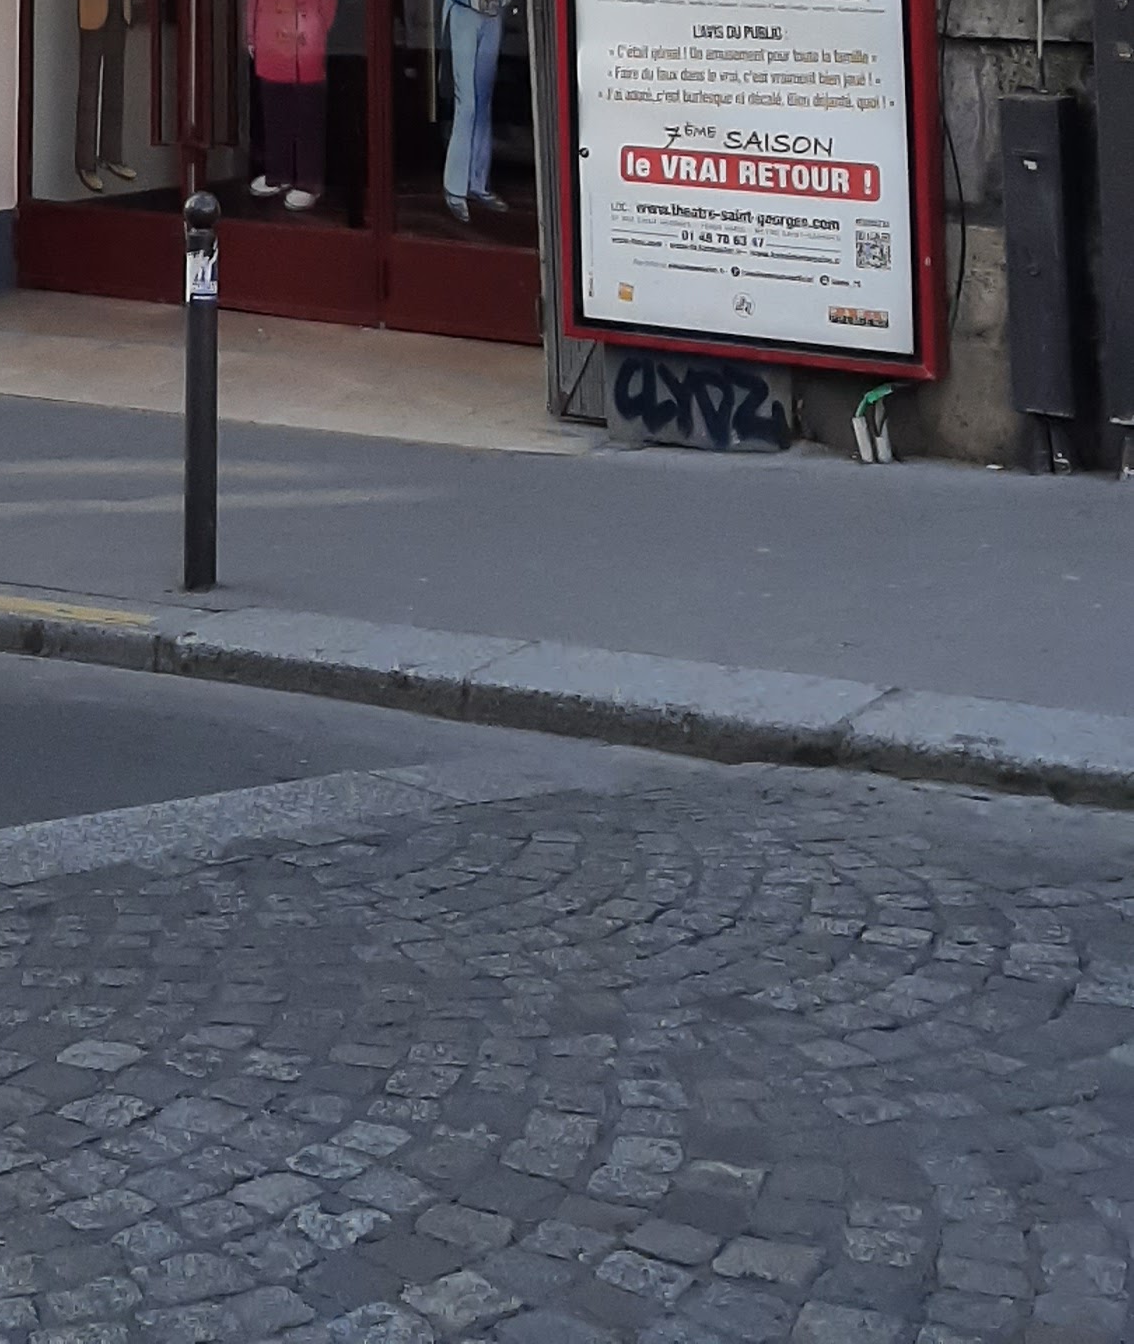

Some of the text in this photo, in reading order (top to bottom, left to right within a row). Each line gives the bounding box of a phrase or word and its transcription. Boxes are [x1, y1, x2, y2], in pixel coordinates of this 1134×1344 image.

[726, 25, 741, 39] DU
[744, 25, 783, 40] PUBLIC
[723, 130, 833, 157] SAISON
[626, 151, 650, 177] le
[661, 154, 727, 184] VRAI
[738, 162, 850, 194] RETOUR
[681, 230, 694, 242] 01
